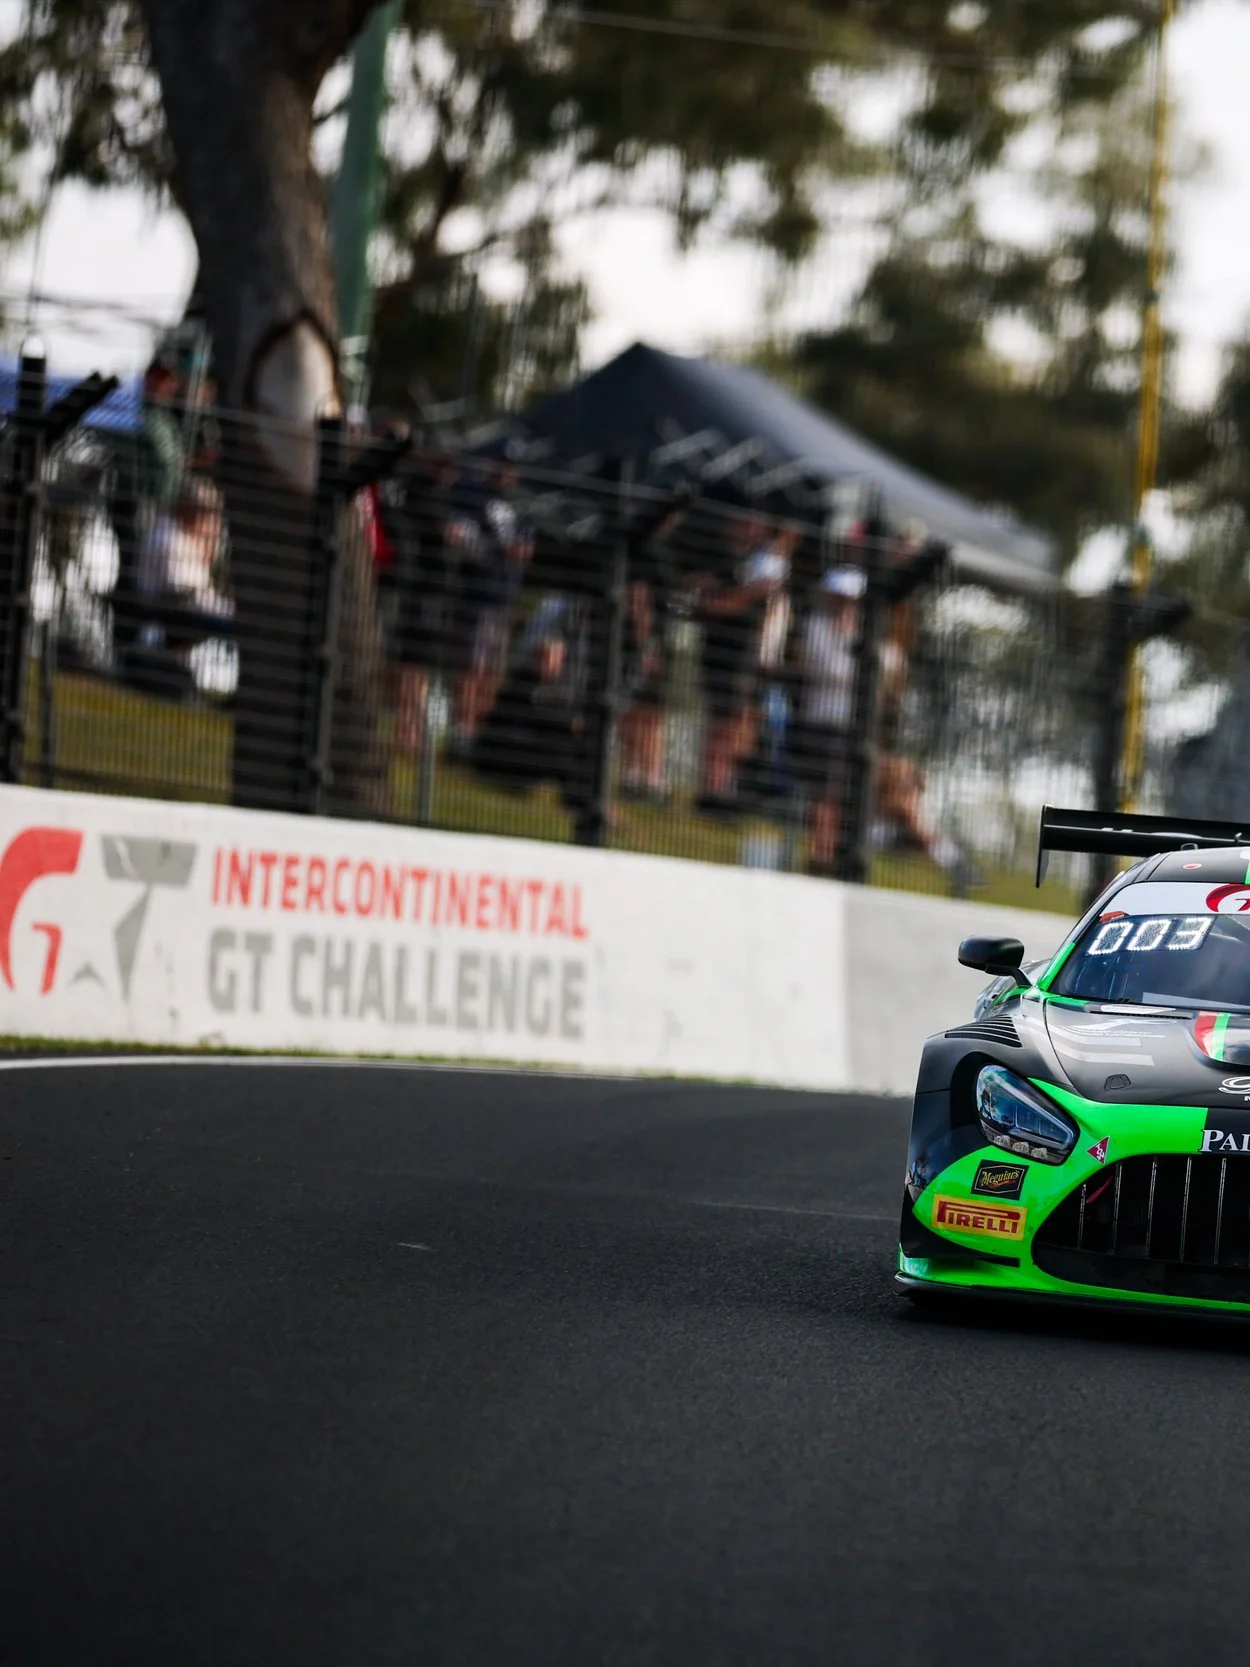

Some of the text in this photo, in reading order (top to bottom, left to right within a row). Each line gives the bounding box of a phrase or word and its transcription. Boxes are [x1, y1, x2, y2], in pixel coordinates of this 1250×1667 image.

[211, 847, 588, 940] INTERCONTINENTAL
[1087, 917, 1212, 955] 003
[207, 928, 587, 1040] GT CHALLENGE
[937, 1200, 1020, 1234] PIRELLI
